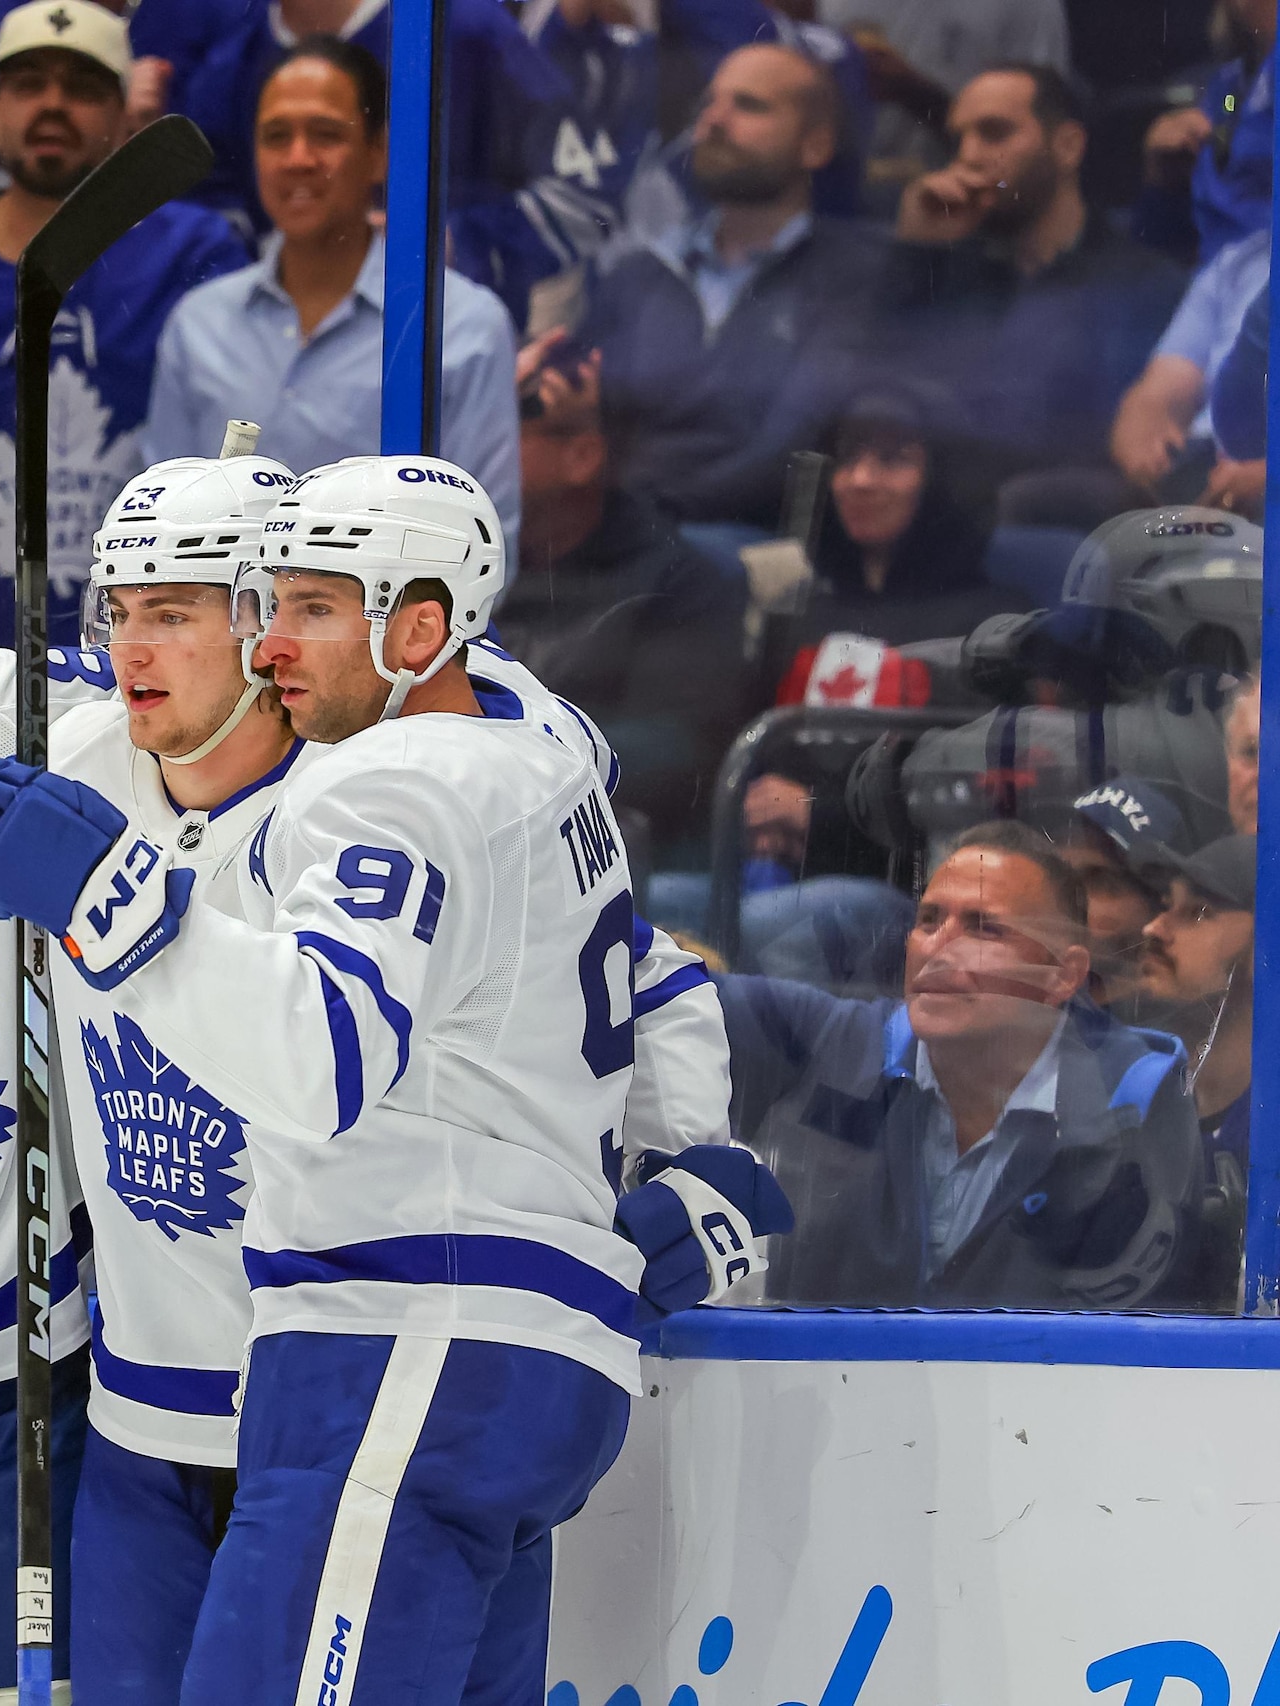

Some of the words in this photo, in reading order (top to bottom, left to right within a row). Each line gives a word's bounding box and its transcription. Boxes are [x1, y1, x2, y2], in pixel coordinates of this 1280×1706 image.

[121, 487, 166, 511] 23
[397, 467, 475, 494] OREO
[106, 536, 158, 551] CCM
[265, 521, 297, 532] CCM
[363, 609, 389, 619] CCM
[86, 833, 164, 940] CM
[334, 844, 446, 945] 91
[33, 937, 45, 977] PRO
[118, 947, 141, 972] LEAFS
[137, 926, 164, 953] MAPLE
[101, 1090, 227, 1149] TORONTO
[117, 1122, 204, 1168] MAPLE
[119, 1153, 206, 1198] LEAFS
[27, 1146, 50, 1361] CCM
[317, 1613, 352, 1706] CCM
